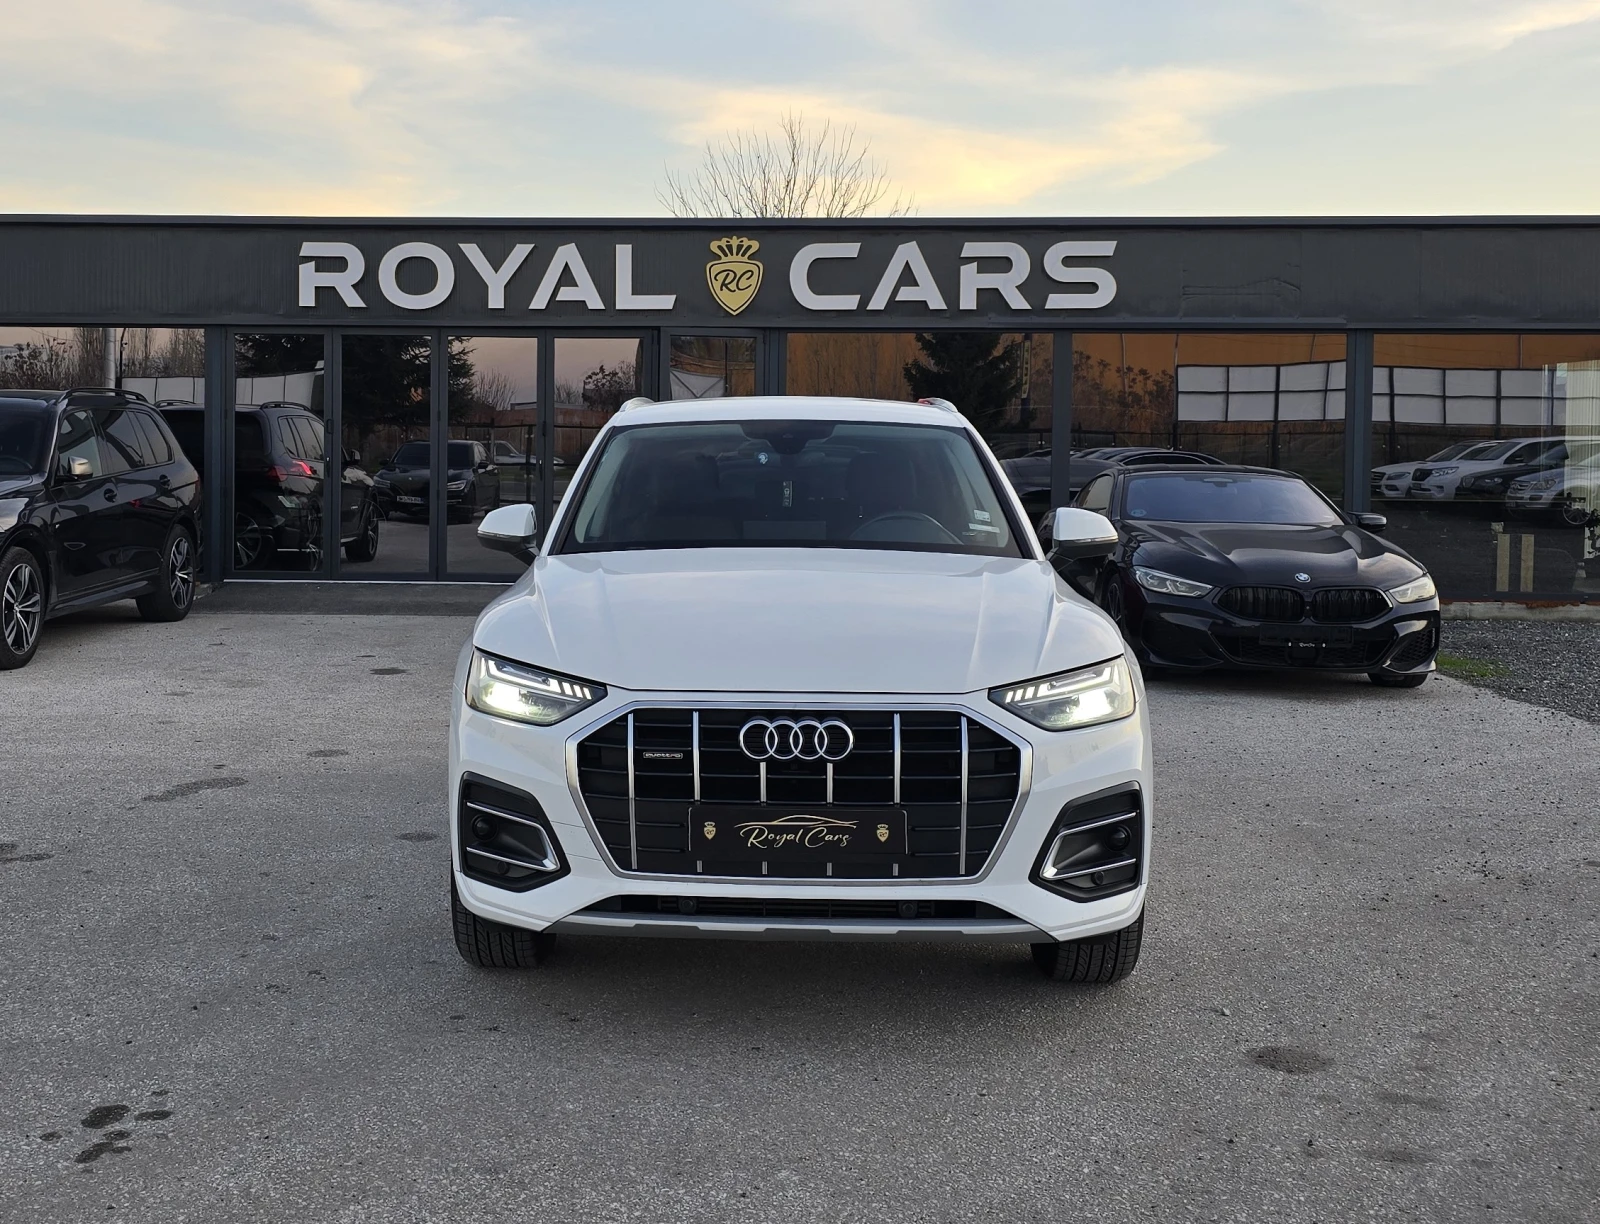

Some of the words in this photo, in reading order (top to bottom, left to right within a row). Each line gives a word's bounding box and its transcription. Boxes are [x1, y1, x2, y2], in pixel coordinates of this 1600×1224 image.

[298, 241, 677, 311] ROYAL
[789, 240, 1118, 311] CARS
[714, 269, 754, 293] RC
[740, 825, 803, 848] Royal
[805, 827, 852, 848] Cars
